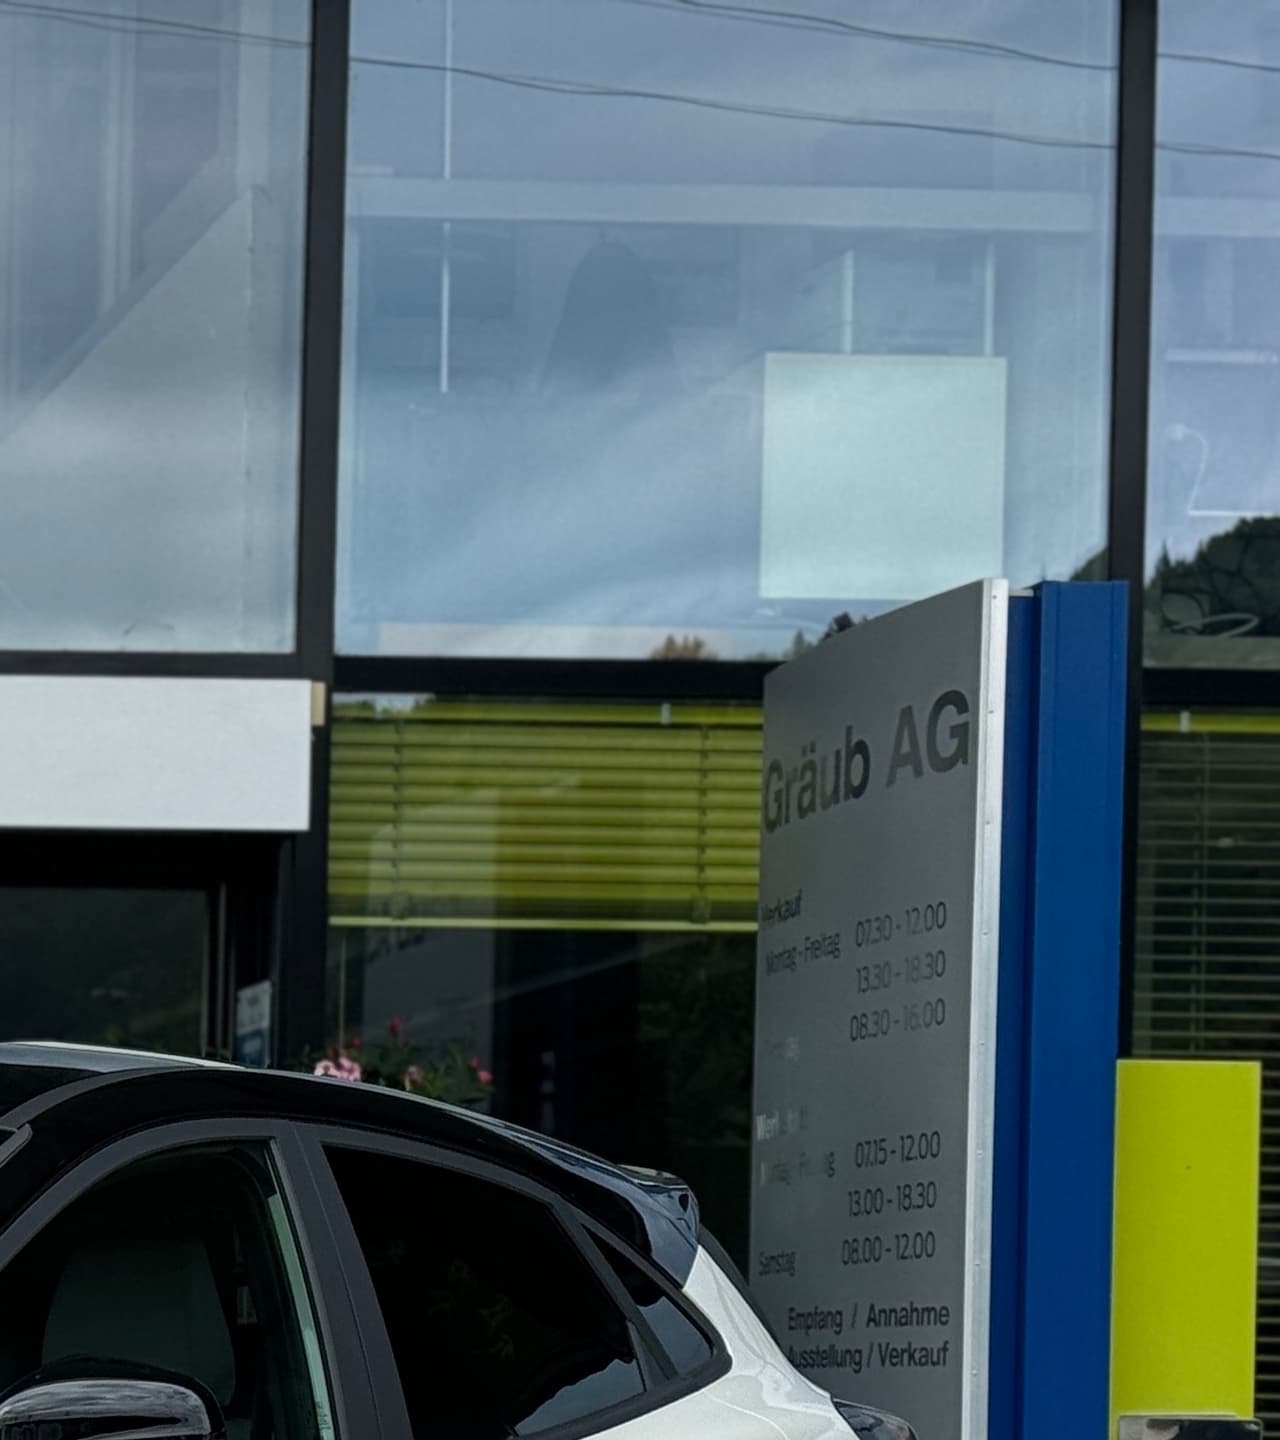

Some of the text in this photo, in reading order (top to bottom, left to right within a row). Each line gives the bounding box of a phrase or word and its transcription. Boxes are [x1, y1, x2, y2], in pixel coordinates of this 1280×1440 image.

[764, 689, 970, 834] Gräub AG
[787, 1305, 844, 1336] Empfang
[866, 1301, 951, 1329] Annahme
[877, 1339, 950, 1368] Verkauf
